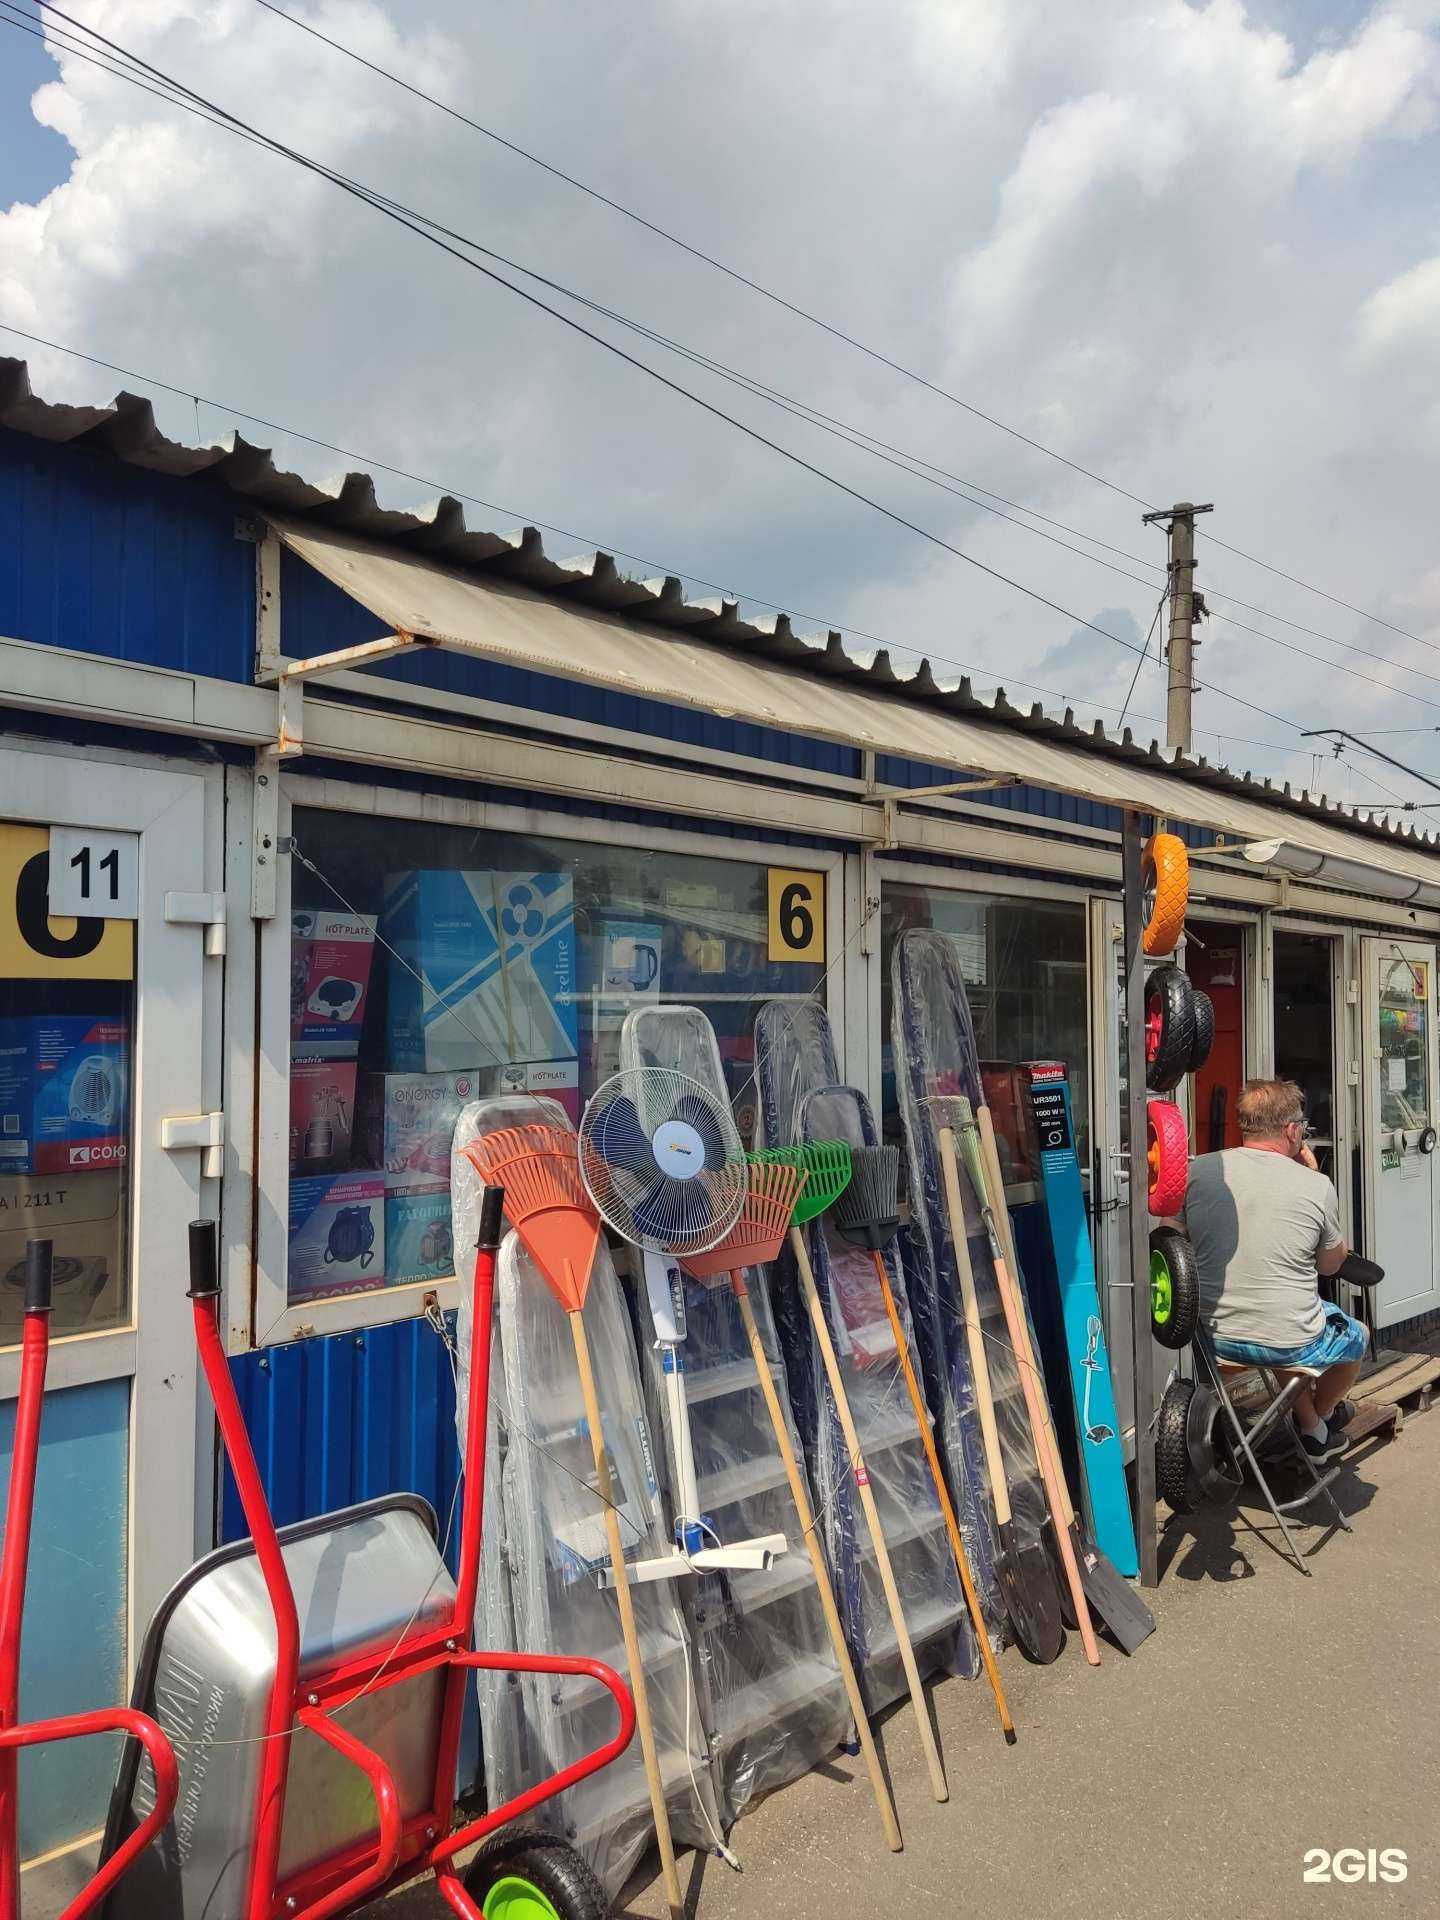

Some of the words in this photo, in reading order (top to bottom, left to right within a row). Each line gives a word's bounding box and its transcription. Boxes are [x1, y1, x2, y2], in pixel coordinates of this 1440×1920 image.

[70, 846, 119, 900] 11
[779, 883, 813, 950] 6
[325, 924, 344, 935] HOT
[345, 925, 370, 936] PLATE
[553, 939, 570, 1007] aceline
[532, 1070, 547, 1081] HOT
[548, 1070, 567, 1080] PLATE
[1033, 1094, 1062, 1105] UR3501
[91, 1144, 127, 1160] СОЮ
